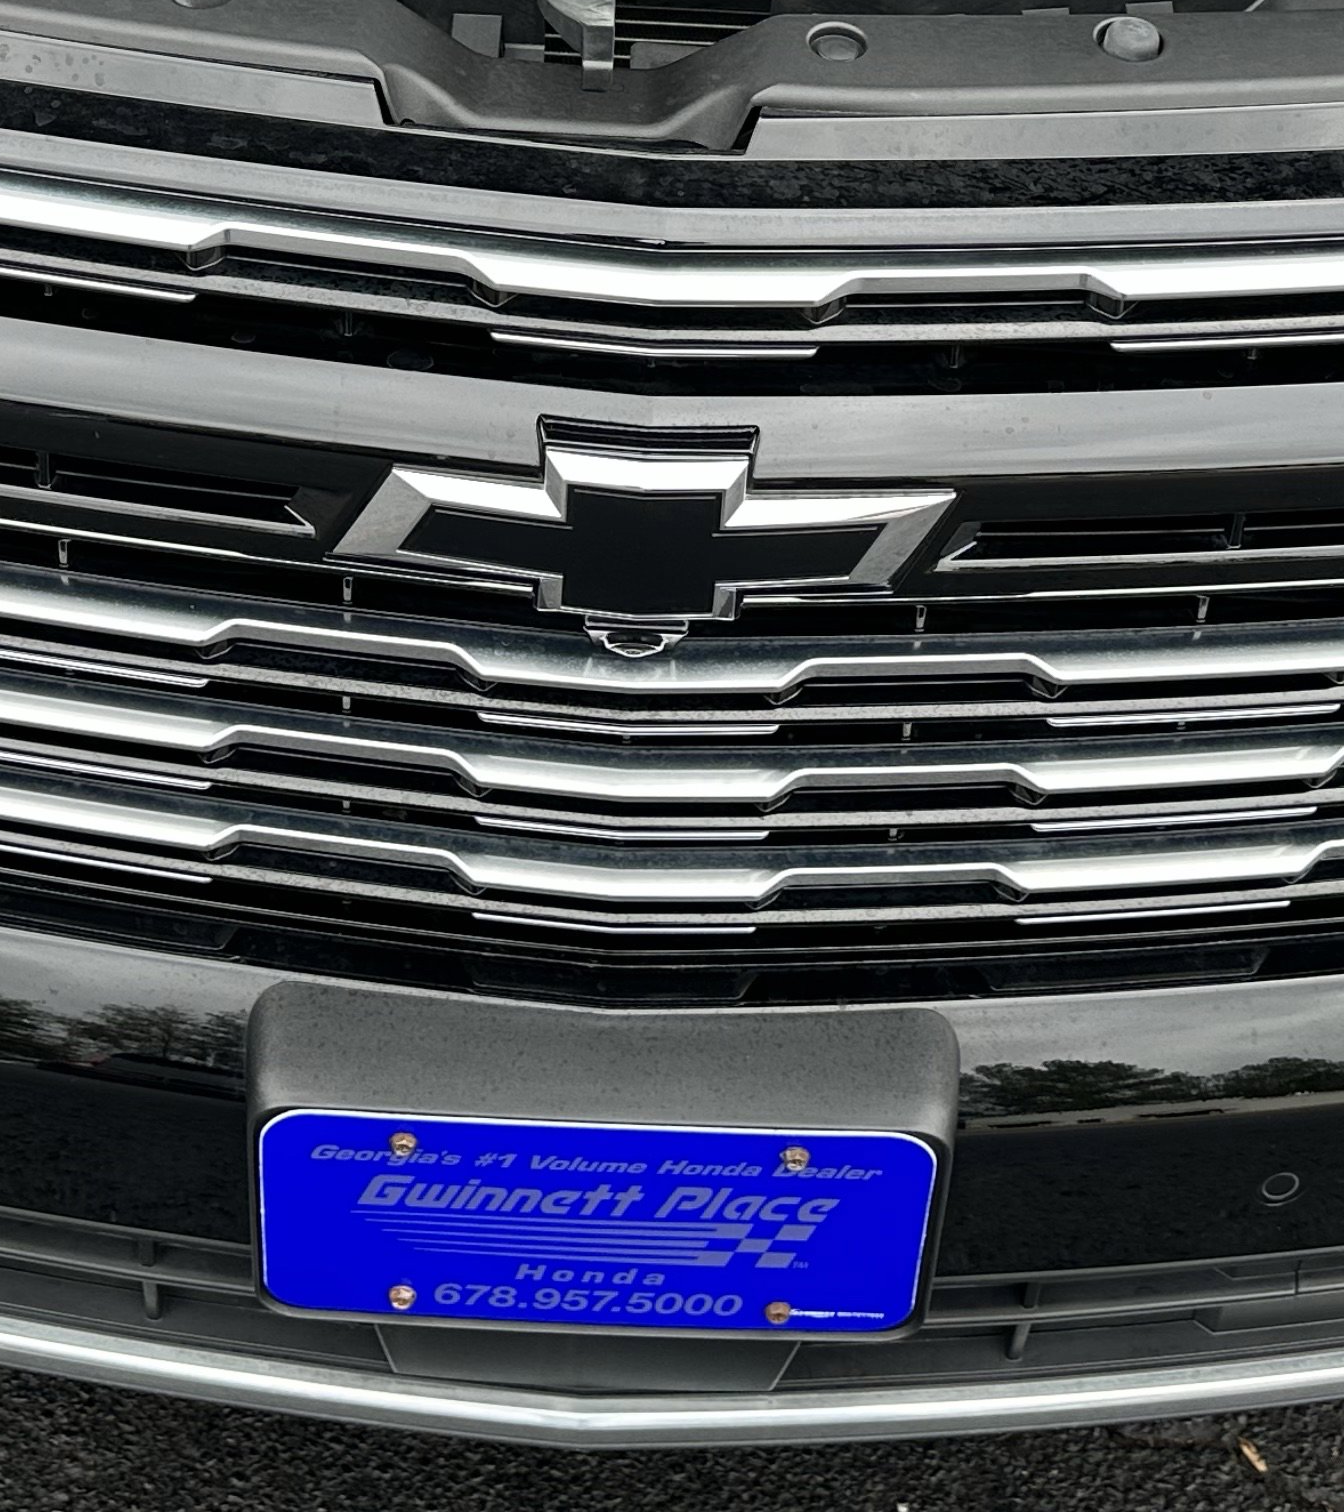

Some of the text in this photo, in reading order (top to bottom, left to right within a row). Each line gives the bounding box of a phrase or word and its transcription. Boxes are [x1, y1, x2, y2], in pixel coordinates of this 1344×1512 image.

[310, 1144, 462, 1166] Georgia's
[474, 1153, 518, 1168] #1
[530, 1155, 648, 1174] Volume
[657, 1160, 763, 1177] Honda
[357, 1174, 841, 1223] Gwinnett Place
[515, 1263, 665, 1286] Honda
[434, 1283, 743, 1316] 678.957.5000
